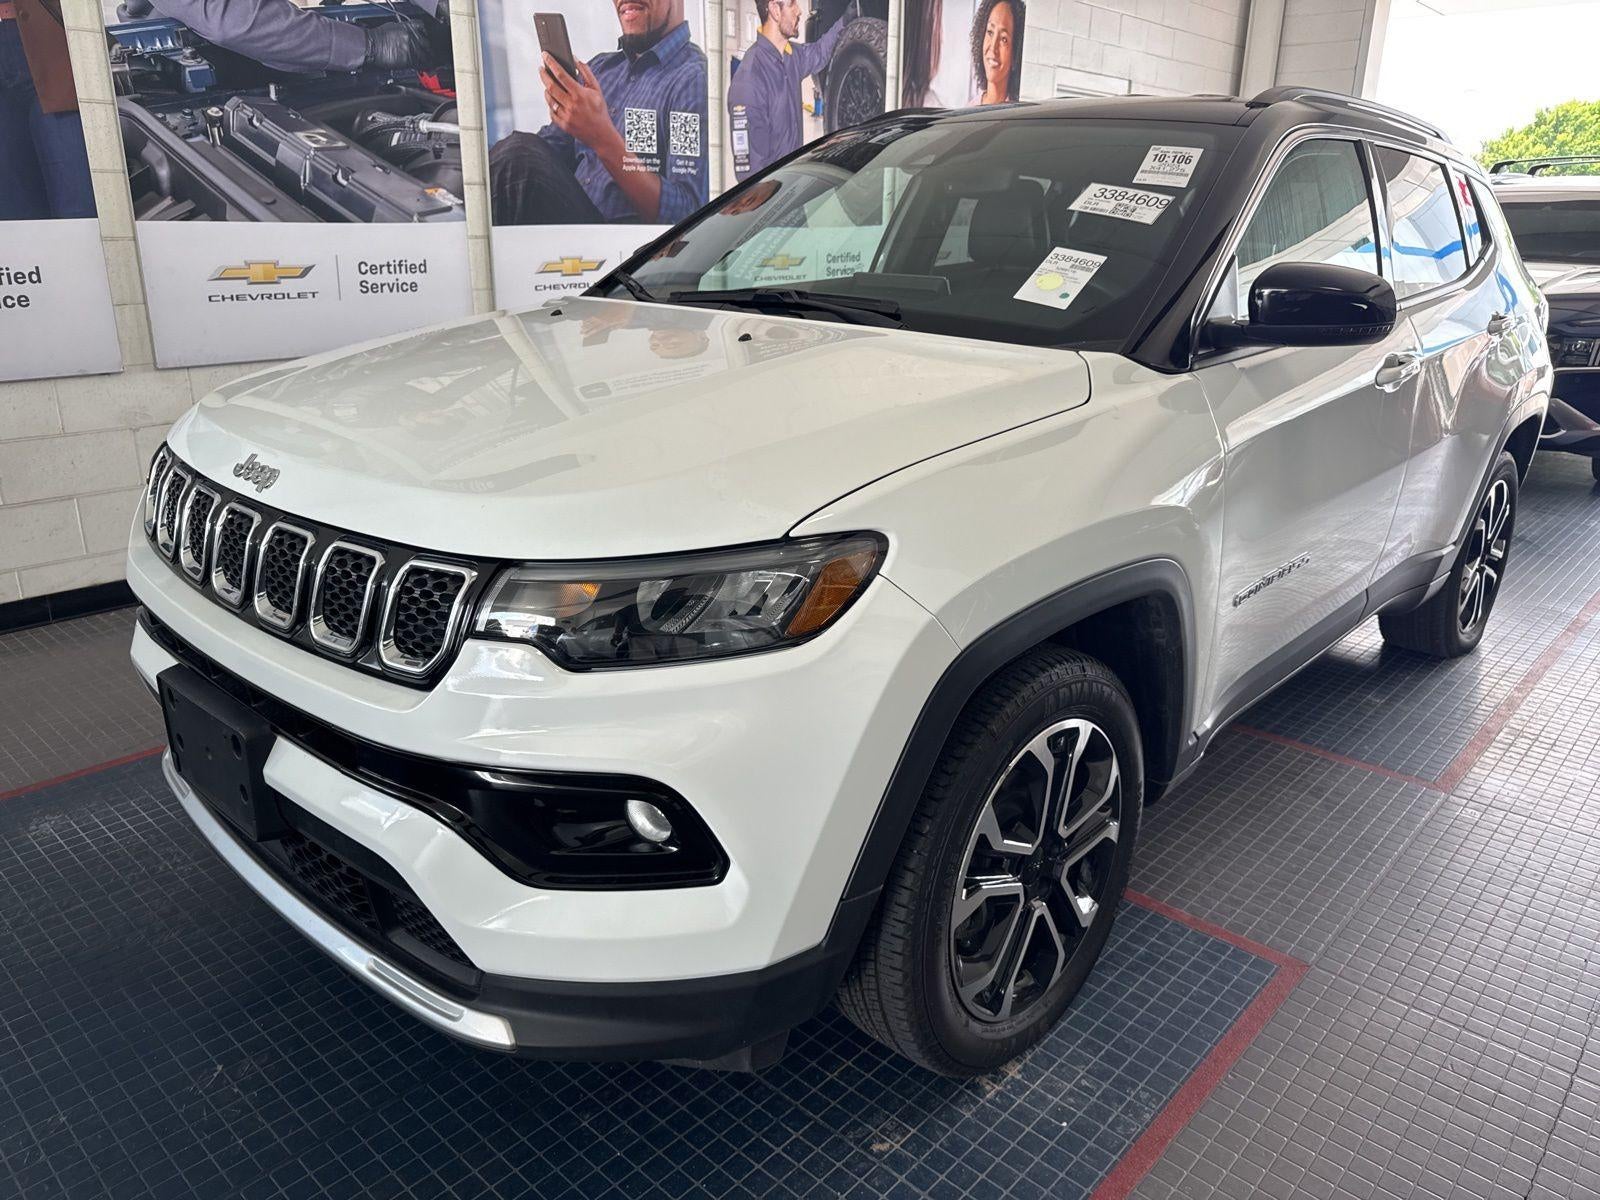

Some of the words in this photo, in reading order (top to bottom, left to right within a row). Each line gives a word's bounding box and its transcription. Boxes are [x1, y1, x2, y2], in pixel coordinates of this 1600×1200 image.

[622, 155, 645, 163] Download
[1152, 153, 1194, 165] 10:106
[622, 164, 636, 172] Apple
[672, 166, 687, 174] Google
[1093, 187, 1170, 209] 3384609
[826, 251, 861, 264] Certified
[1050, 253, 1102, 269] 3384609
[358, 259, 428, 276] Certified
[754, 274, 807, 282] CHEVROLET
[359, 278, 419, 294] Service
[534, 282, 593, 292] CHEVROL
[0, 294, 30, 309] ce
[208, 291, 320, 303] CHEVROLET
[233, 453, 280, 493] Jeep
